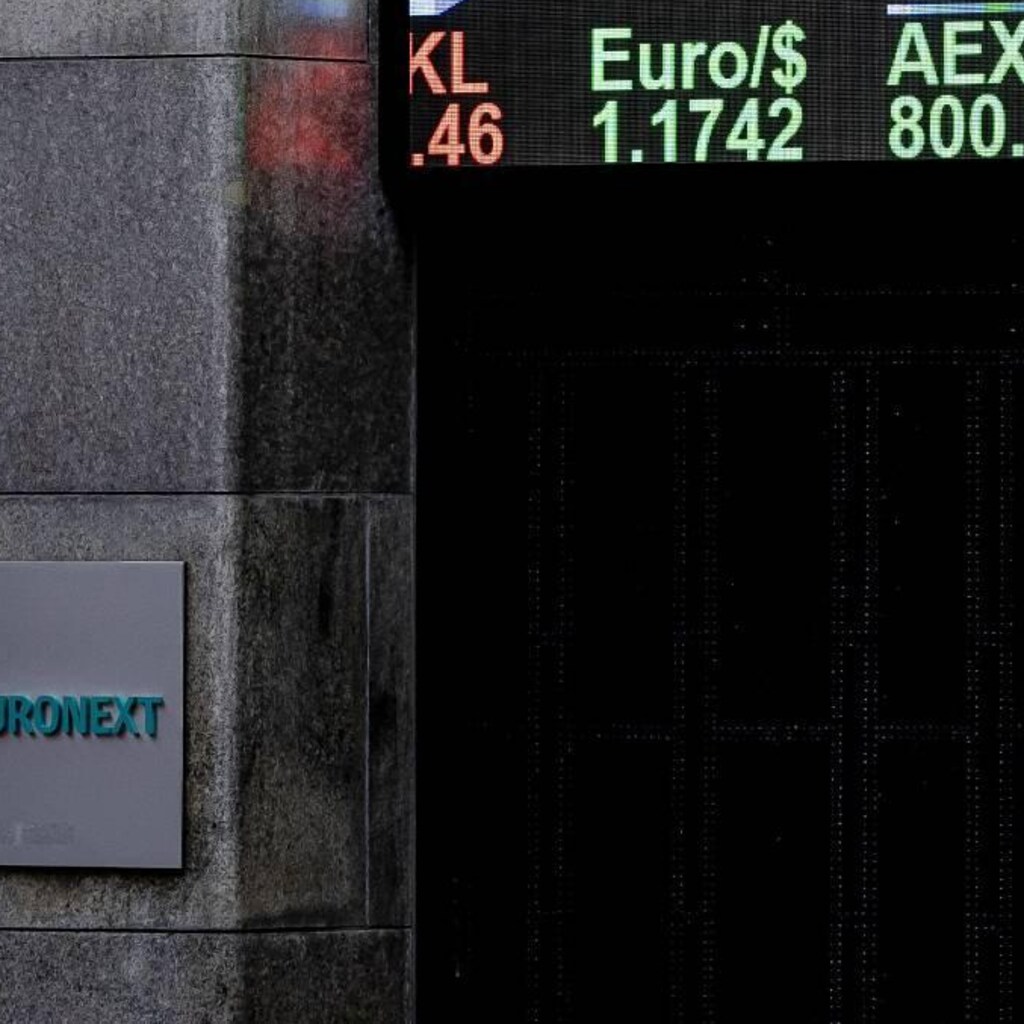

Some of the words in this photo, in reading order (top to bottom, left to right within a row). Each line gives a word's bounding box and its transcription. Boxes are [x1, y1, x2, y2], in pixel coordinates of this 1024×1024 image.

[409, 31, 489, 94] KL
[591, 21, 807, 94] Euro/$
[411, 102, 503, 166] .46
[592, 97, 802, 163] 1.1742
